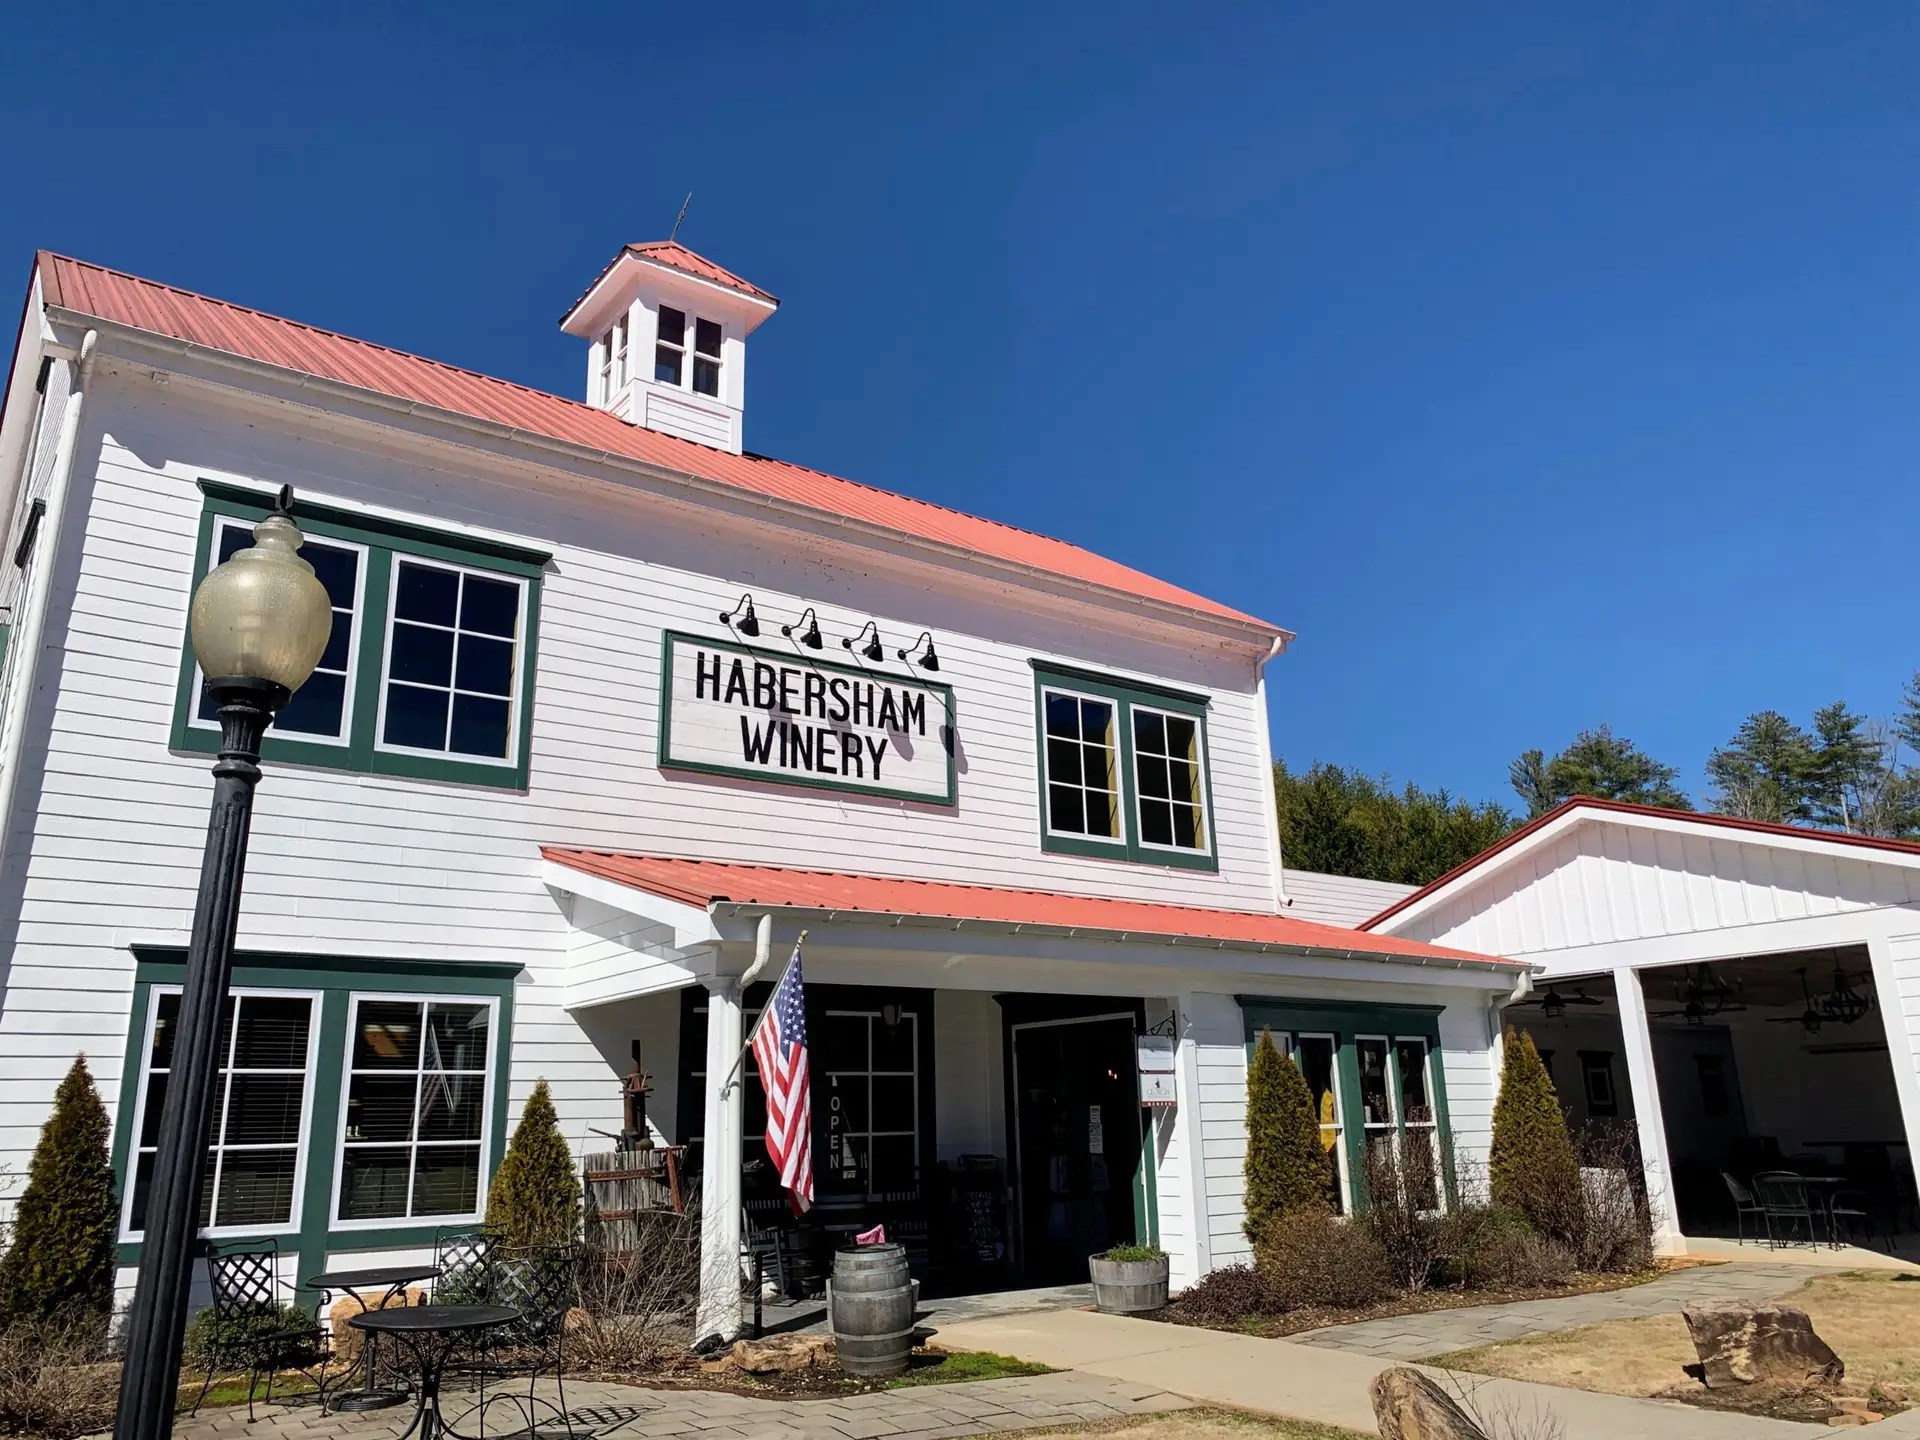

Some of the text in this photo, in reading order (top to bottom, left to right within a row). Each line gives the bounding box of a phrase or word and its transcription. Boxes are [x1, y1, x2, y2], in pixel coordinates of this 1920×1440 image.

[696, 651, 926, 736] HABERSHAM
[740, 715, 888, 781] WINERY
[830, 1096, 841, 1168] OPEN
